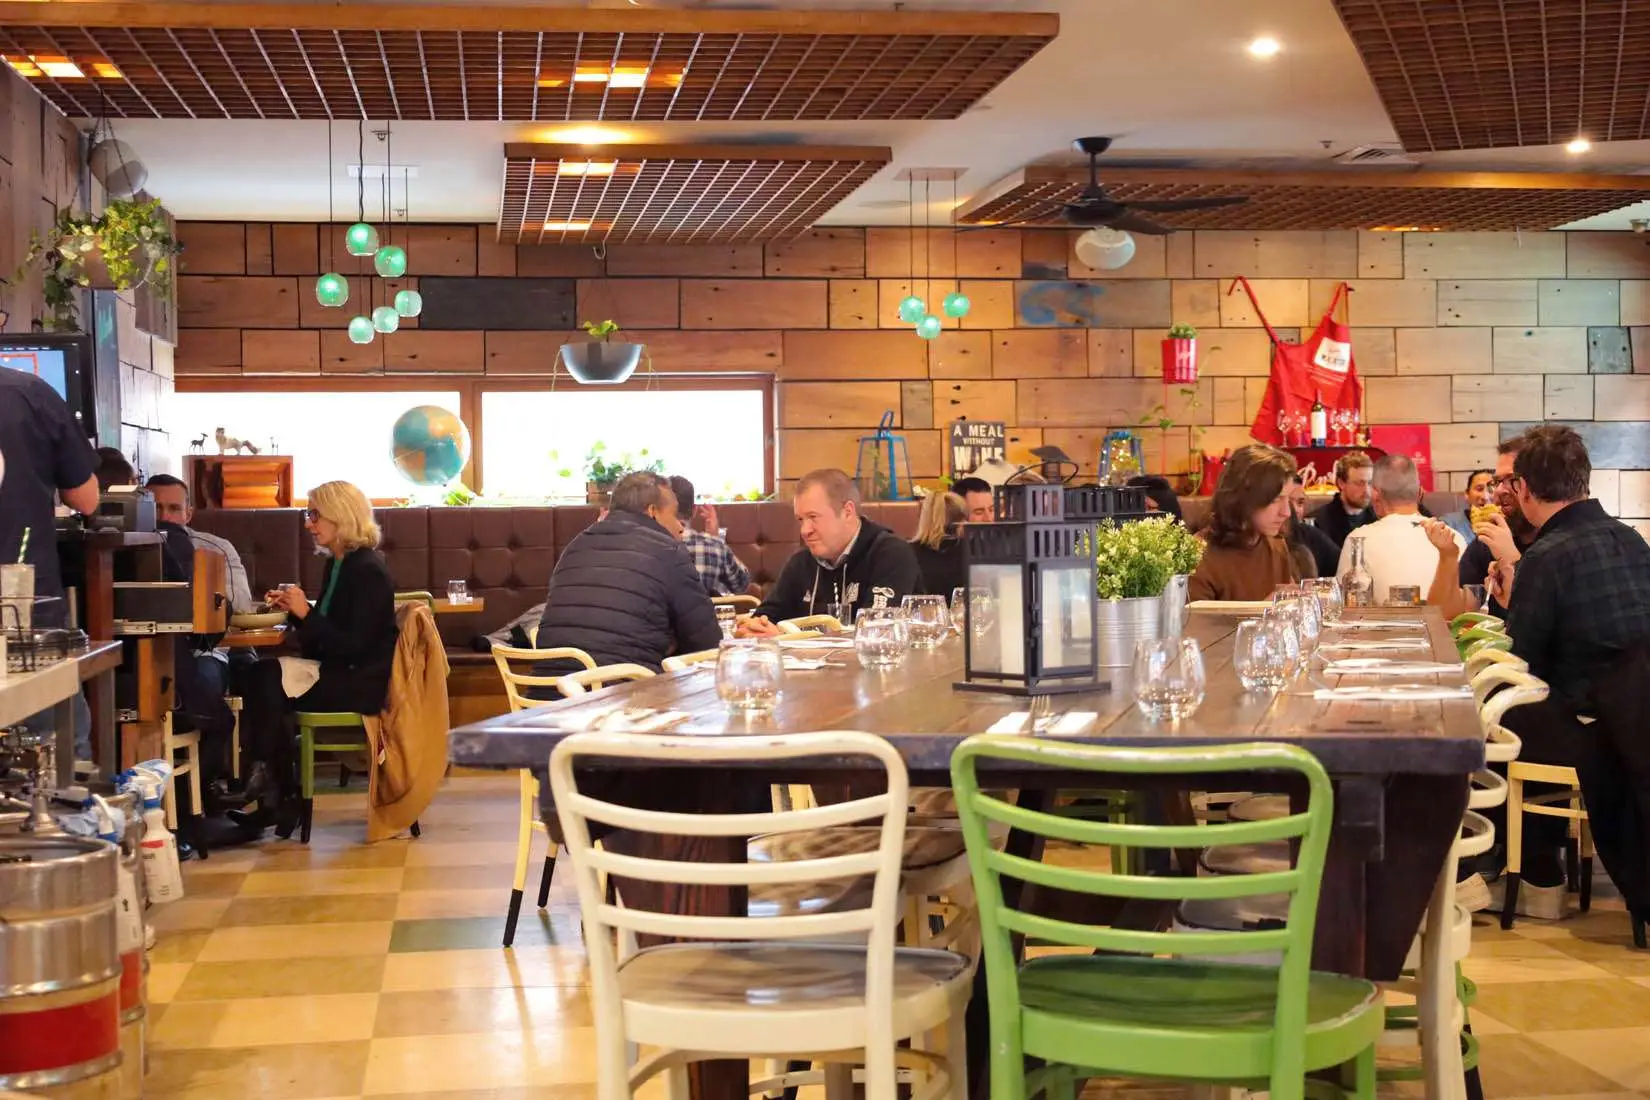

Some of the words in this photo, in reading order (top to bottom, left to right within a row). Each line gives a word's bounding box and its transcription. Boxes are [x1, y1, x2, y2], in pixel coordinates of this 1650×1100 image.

[953, 424, 963, 437] A
[968, 424, 1004, 437] MEAL
[962, 437, 995, 445] WITHOUT
[953, 446, 1004, 470] WINE
